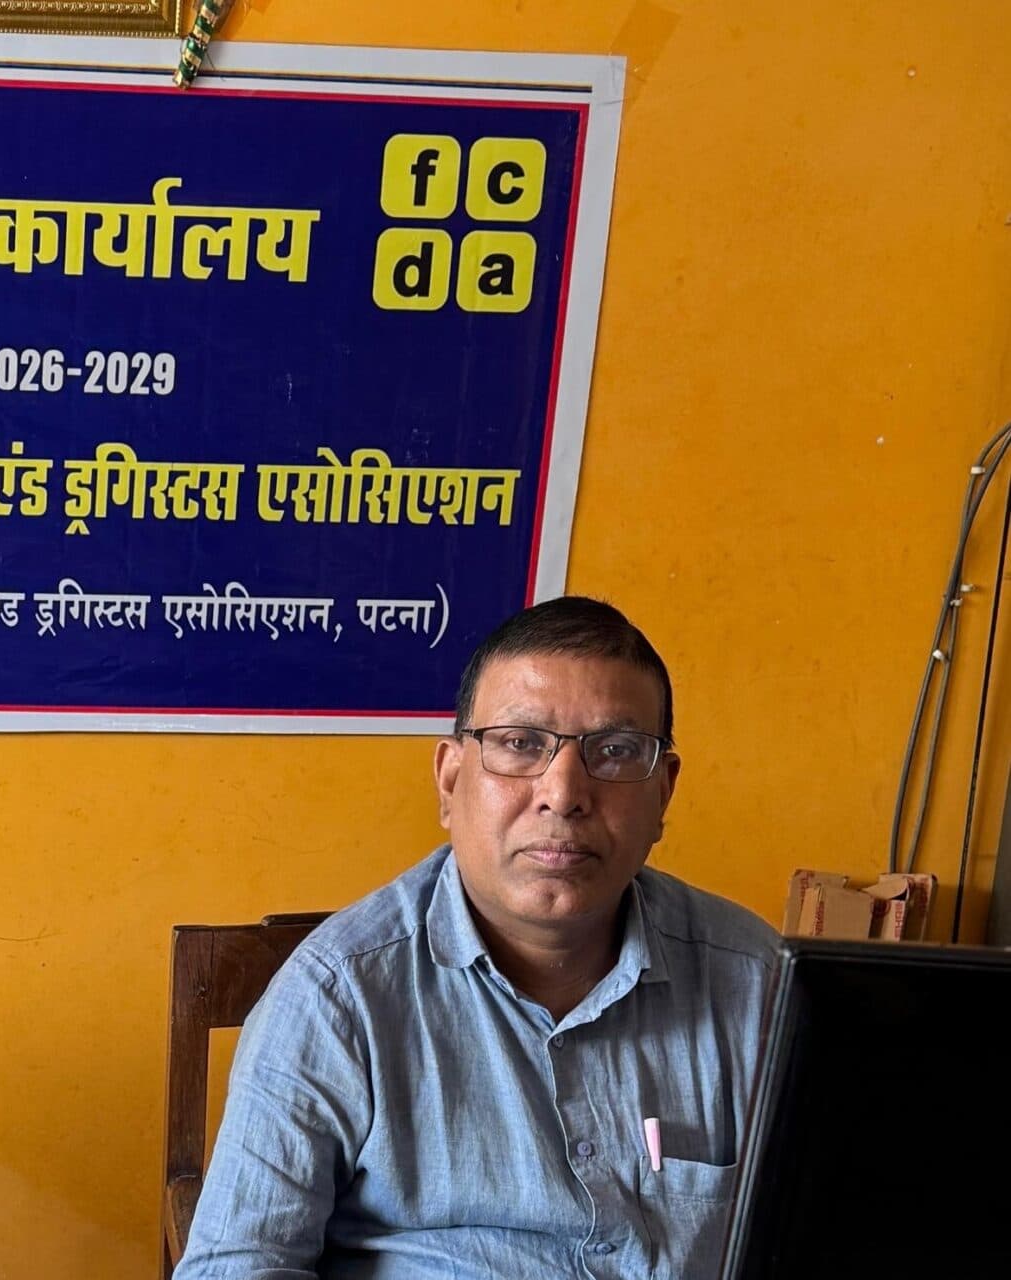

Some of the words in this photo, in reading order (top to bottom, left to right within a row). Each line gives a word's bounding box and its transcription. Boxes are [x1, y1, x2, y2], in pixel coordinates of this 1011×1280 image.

[410, 149, 440, 207] f
[392, 241, 434, 298] d
[477, 253, 515, 296] a
[64, 442, 245, 535] ड्रगिस्टस
[256, 447, 521, 525] एसोसिएशन
[33, 578, 152, 637] ड्रगिस्टस
[161, 581, 343, 642] एसोसिएशन,
[356, 583, 449, 649] पटना)
